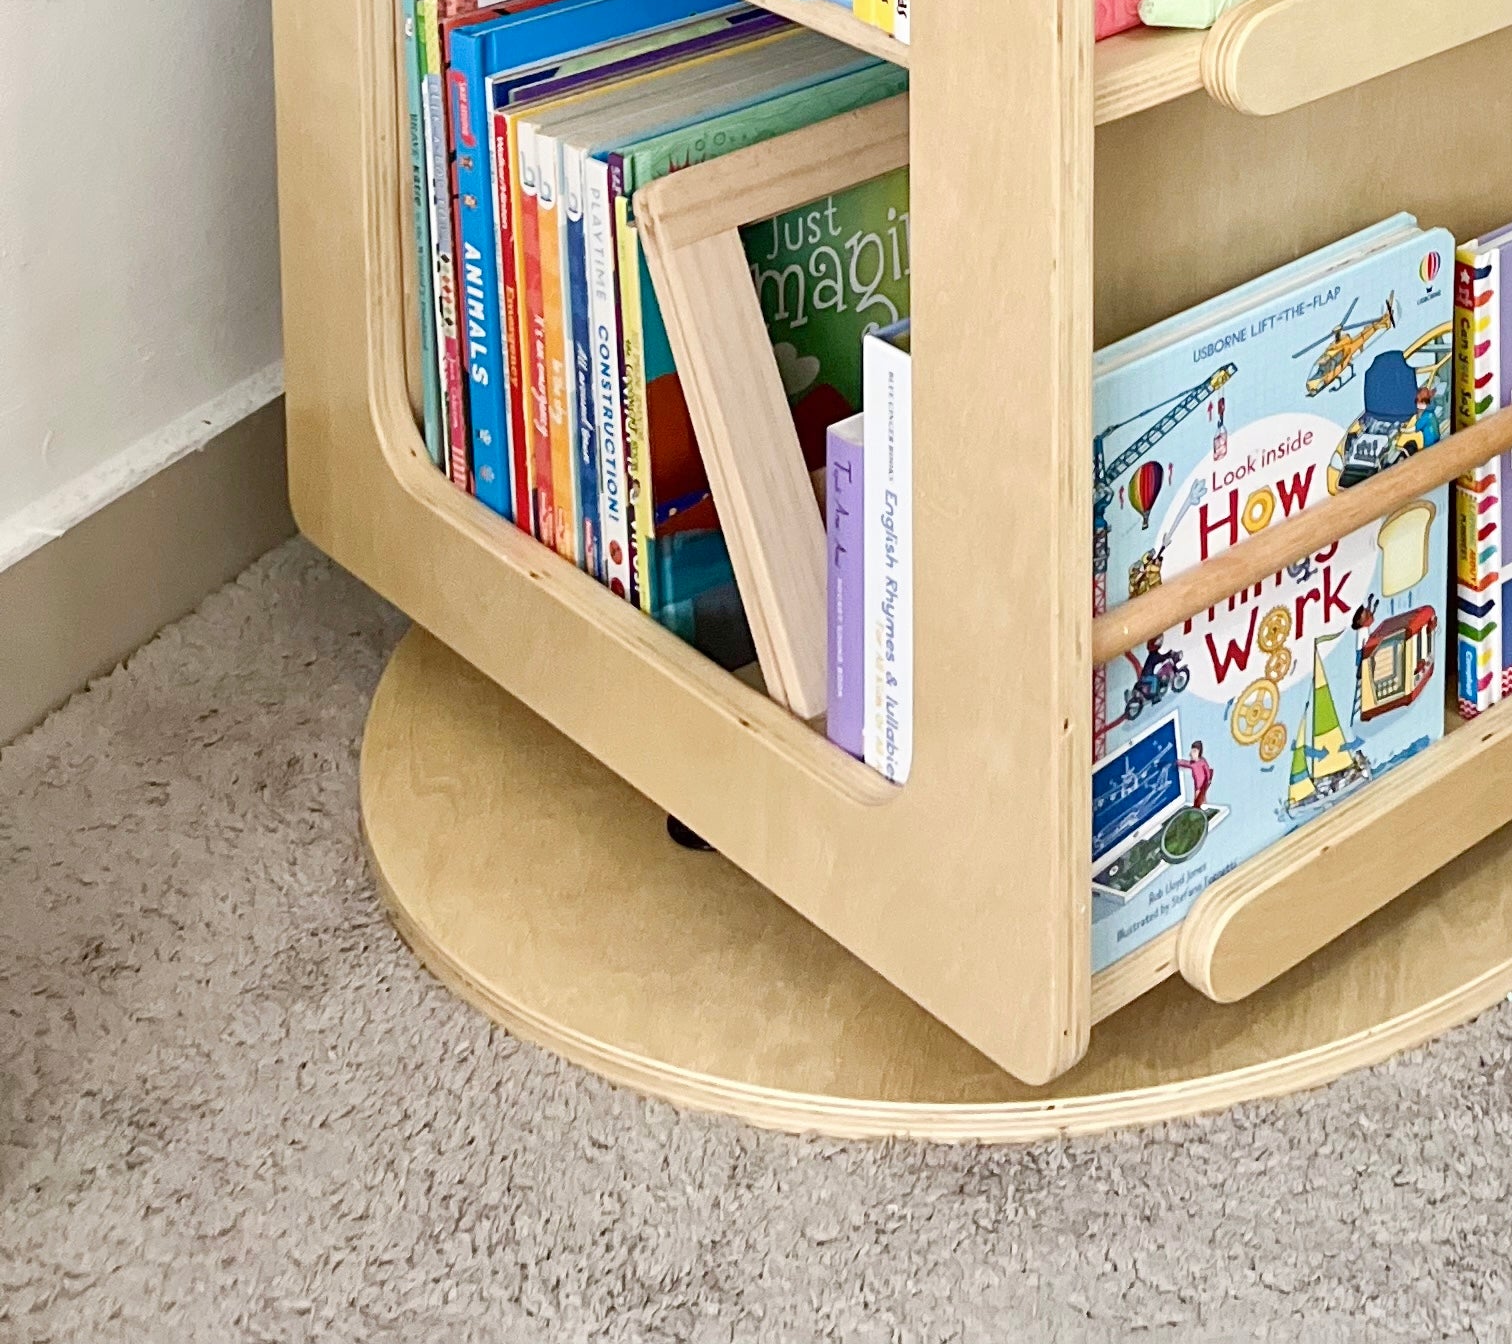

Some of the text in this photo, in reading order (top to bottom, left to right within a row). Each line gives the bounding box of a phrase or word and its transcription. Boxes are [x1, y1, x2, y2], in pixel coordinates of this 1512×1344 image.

[766, 195, 842, 260] Just
[463, 241, 490, 387] ANIMALS
[505, 284, 520, 389] Emergency
[590, 187, 620, 522] PLAYTIME CONSTRUCTION!
[1192, 286, 1342, 363] USBORNE LIFT-THE-FLAP
[1211, 429, 1314, 493] Look inside
[880, 488, 899, 569] English
[880, 575, 899, 662] Rhymes
[884, 671, 898, 688] &
[1465, 650, 1473, 697] Campbell
[885, 695, 899, 784] lullabie
